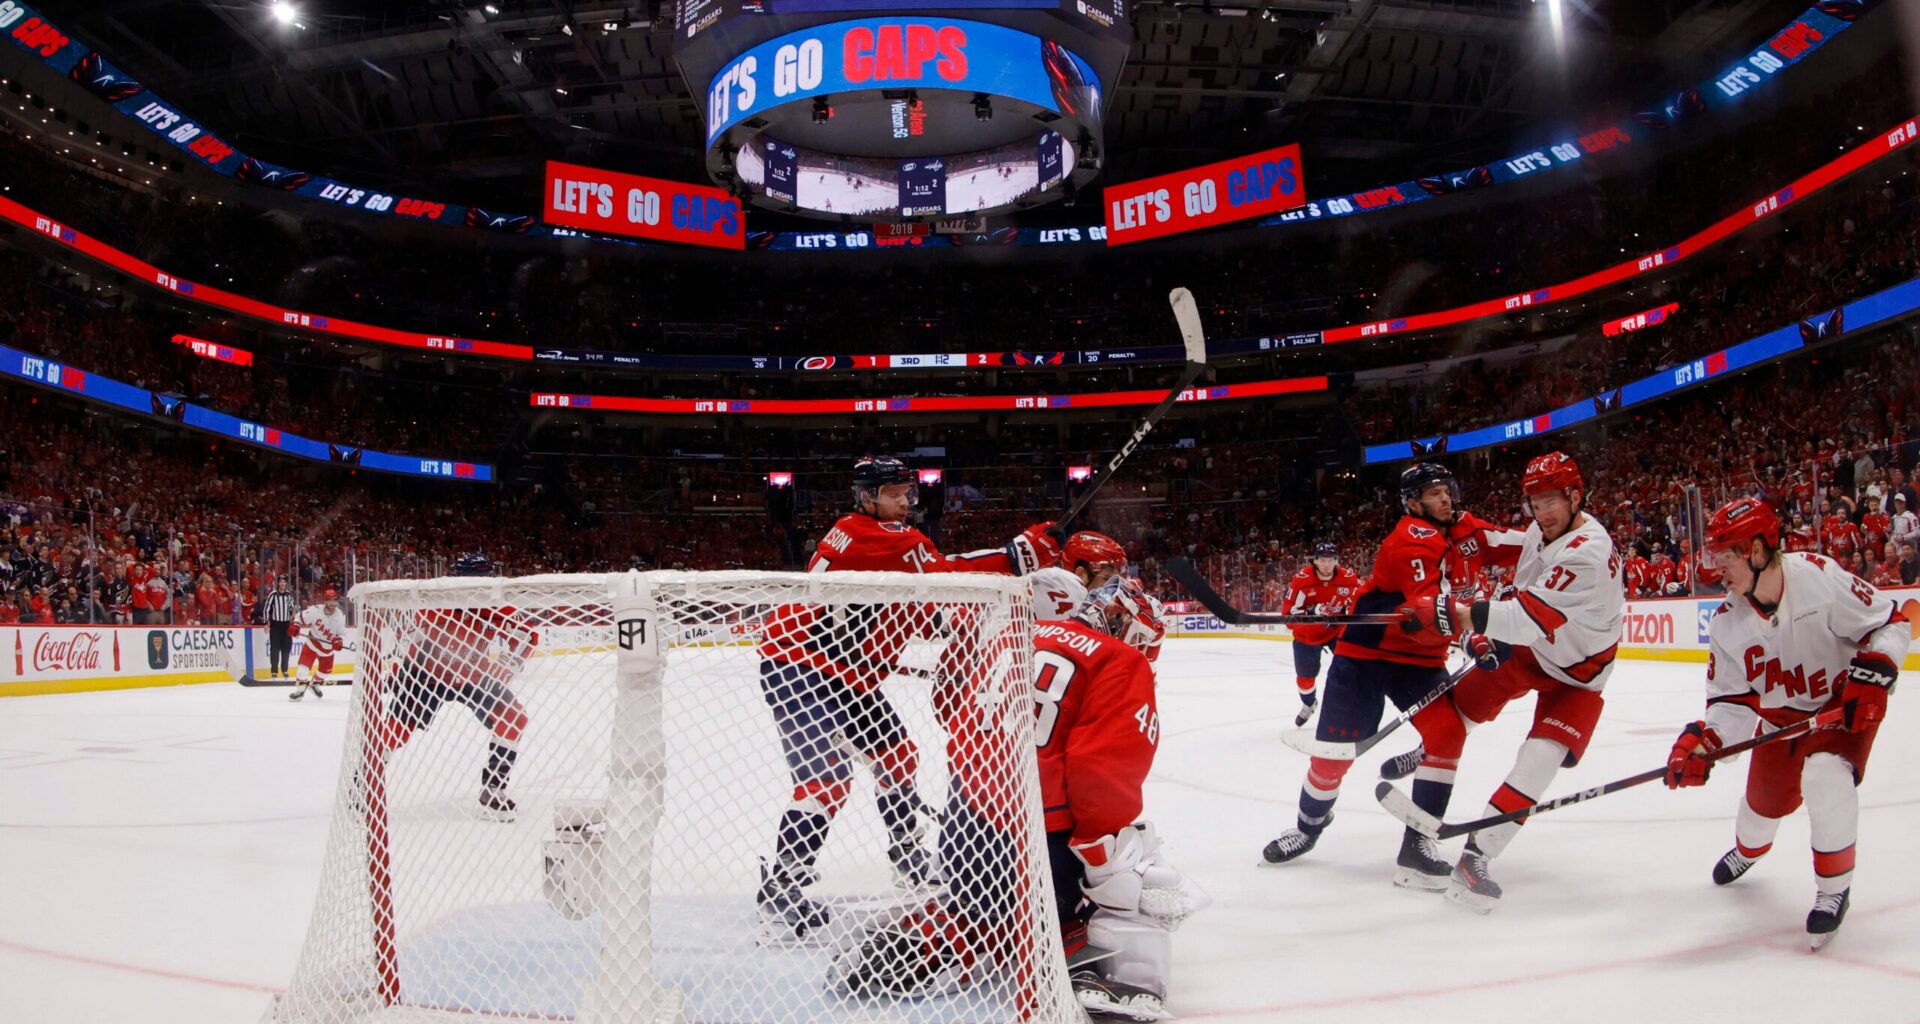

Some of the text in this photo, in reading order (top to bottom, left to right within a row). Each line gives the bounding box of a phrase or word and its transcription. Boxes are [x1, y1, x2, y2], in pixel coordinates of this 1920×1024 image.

[696, 7, 722, 27] CAESARS
[1086, 5, 1114, 25] CAESARS
[12, 17, 70, 57] CAPS
[1715, 21, 1823, 97] LET'S GO CAPS
[709, 25, 967, 139] LET'S GO CAPS
[135, 102, 234, 164] LET'S GO CAPS
[1888, 128, 1905, 147] LET'S
[1906, 122, 1917, 138] GO
[1506, 127, 1633, 175] LET'S GO CAPS
[932, 179, 938, 188] 2
[319, 184, 446, 219] LET'S GO CAPS
[1112, 157, 1298, 231] LET'S GO CAPS
[1328, 198, 1354, 214] GO
[1353, 186, 1405, 209] CAPS
[553, 178, 739, 236] LET'S GO CAPS
[796, 235, 837, 247] LET'S
[846, 233, 869, 247] GO
[1040, 229, 1082, 243] LET'S
[1506, 296, 1521, 309] LET'S
[1522, 294, 1531, 305] GO
[284, 311, 299, 324] LET'S
[301, 314, 310, 326] GO
[1361, 325, 1377, 336] LET'S
[1379, 323, 1388, 333] GO
[427, 337, 442, 348] LET'S
[445, 338, 454, 349] GO
[614, 356, 640, 364] PENALTY:
[754, 361, 765, 369] 26
[870, 356, 876, 366] 1
[901, 357, 920, 365] 3RD
[978, 354, 987, 364] 2
[22, 356, 86, 392] LET'S GO CAPS
[1675, 366, 1692, 386] LET'S
[1695, 360, 1704, 379] GO
[537, 395, 556, 406] LET'S
[559, 396, 569, 407] GO
[1015, 397, 1034, 408] LET'S
[1037, 397, 1048, 408] GO
[1197, 389, 1207, 400] GO
[696, 401, 713, 412] LET'S
[717, 402, 727, 413] GO
[855, 400, 873, 411] LET'S
[877, 400, 887, 411] GO
[240, 422, 254, 438] LET'S
[256, 425, 264, 442] GO
[1505, 420, 1521, 438] LET'S
[1524, 418, 1533, 434] GO
[1110, 421, 1152, 472] CCM
[421, 460, 439, 474] LET'S
[442, 462, 451, 474] GO
[1728, 504, 1750, 519] Lenovo
[1459, 538, 1479, 556] 50
[902, 542, 937, 573] 74
[1410, 558, 1425, 582] 3
[1544, 565, 1577, 591] 37
[1850, 575, 1874, 608] 53
[1047, 591, 1074, 616] 24
[314, 618, 337, 642] CANE
[1185, 615, 1227, 630] GEICO
[172, 630, 234, 650] CAESARS
[33, 631, 101, 671] Coca-Cola
[1707, 651, 1716, 681] 3
[1134, 704, 1159, 745] 48
[1529, 783, 1605, 815] CCM
